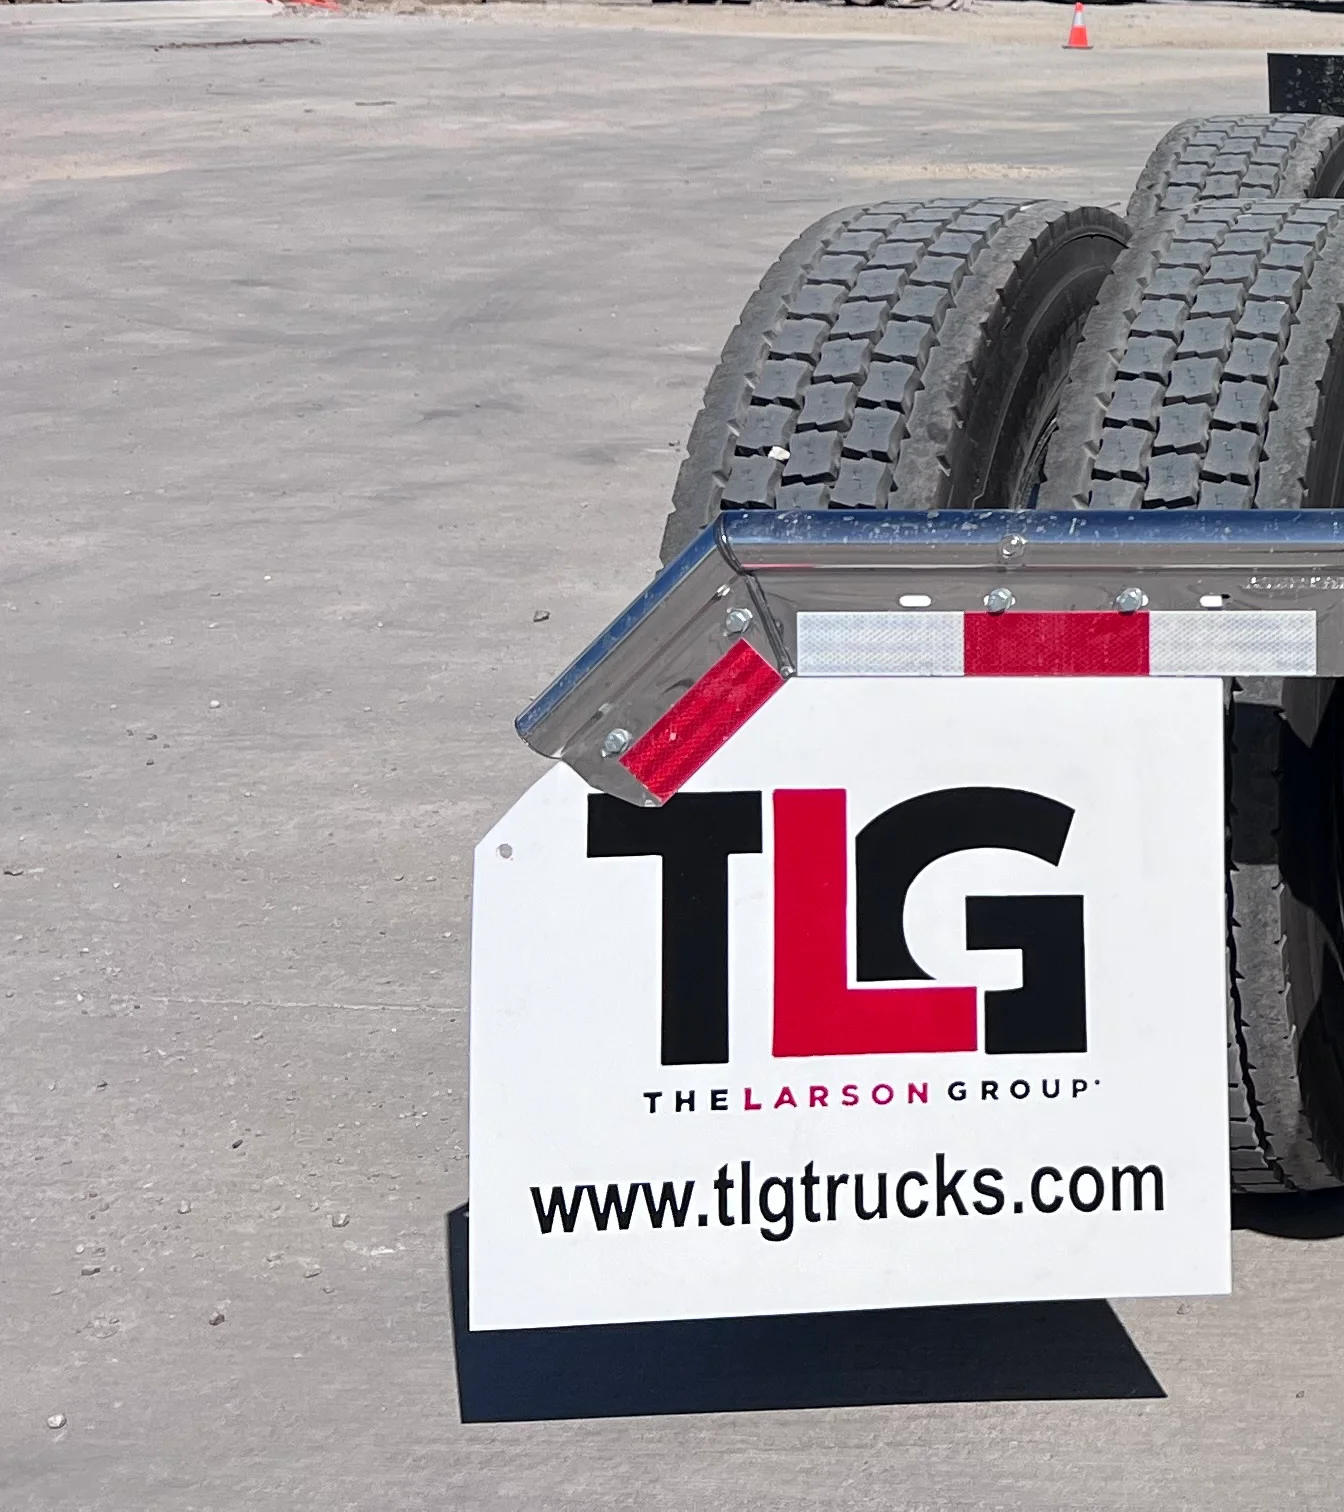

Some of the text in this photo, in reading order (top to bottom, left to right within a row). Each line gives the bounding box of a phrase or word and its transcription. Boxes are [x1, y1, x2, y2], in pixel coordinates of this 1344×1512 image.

[587, 786, 1088, 1066] TLG
[643, 1078, 1088, 1114] THE LARSON GROUP
[530, 1152, 1164, 1242] www.tlgtrucks.com
